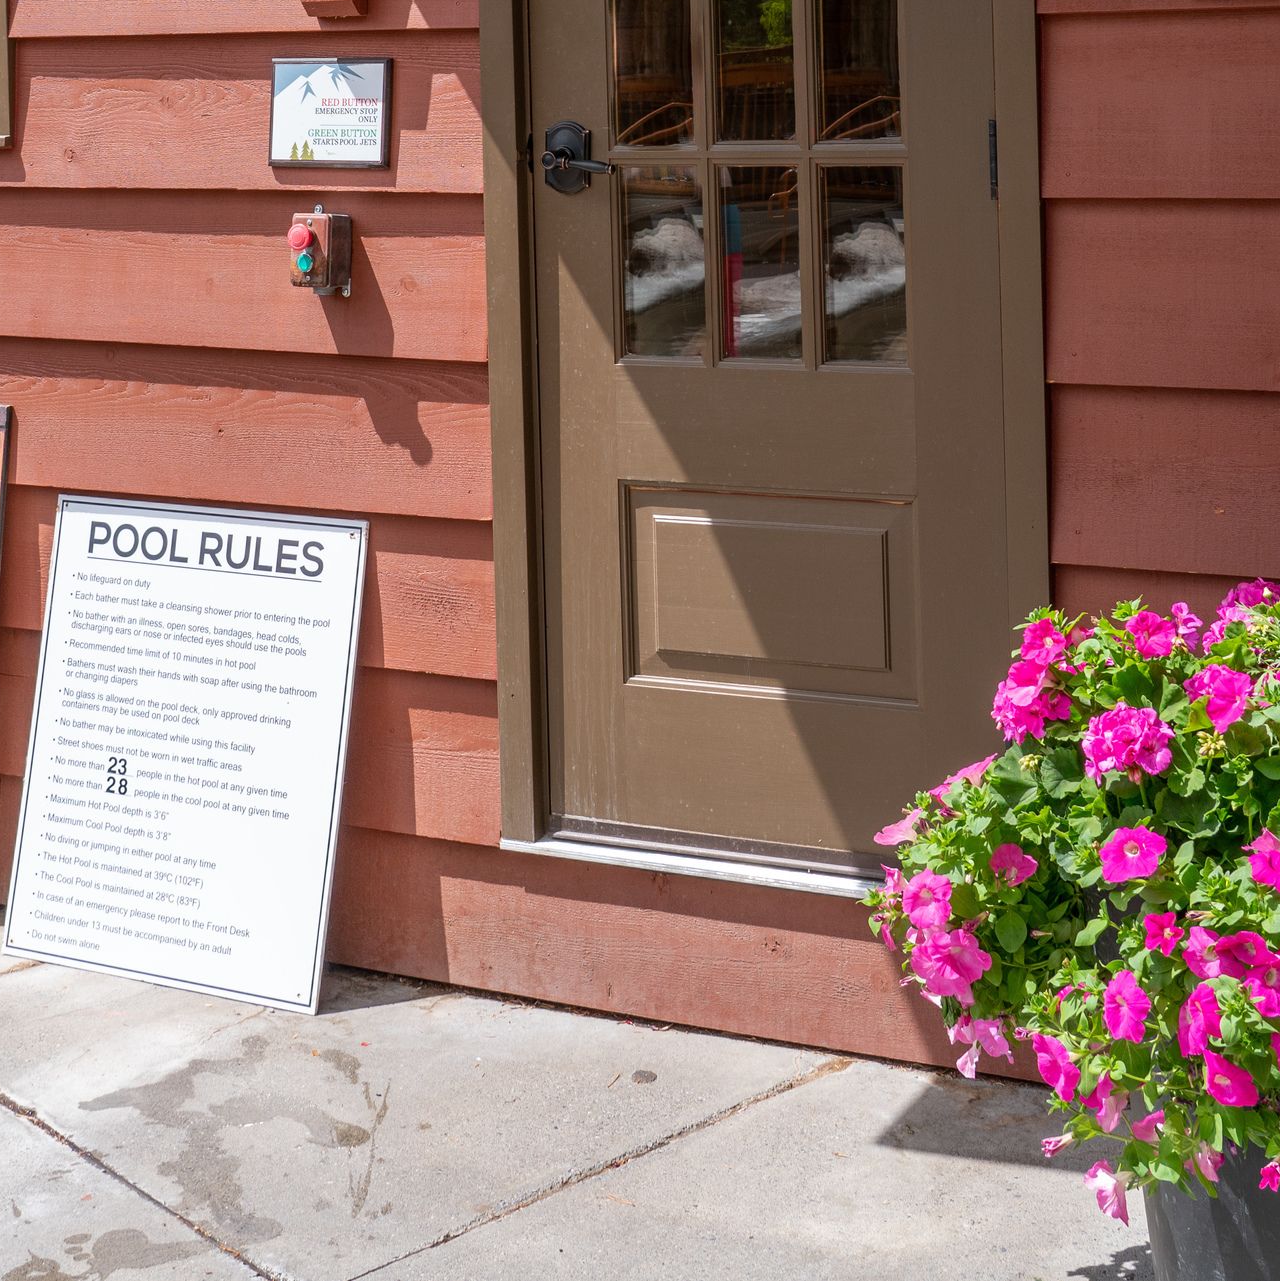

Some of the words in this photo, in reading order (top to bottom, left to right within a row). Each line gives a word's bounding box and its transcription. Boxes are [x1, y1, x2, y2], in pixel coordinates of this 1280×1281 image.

[322, 98, 339, 106] RED
[342, 98, 378, 106] BUTTON
[308, 129, 338, 137] GREEN
[341, 129, 377, 137] BUTTON
[87, 520, 188, 563] POOL
[197, 531, 324, 577] RULES
[76, 571, 88, 581] No
[89, 572, 122, 585] lifeguard
[122, 578, 133, 586] on
[134, 578, 151, 589] duty
[72, 608, 84, 619] No
[84, 610, 109, 621] bather
[110, 614, 126, 623] with
[138, 616, 164, 629] illness,
[166, 621, 186, 631] open
[187, 624, 211, 635] sores,
[212, 625, 254, 640] bandages,
[255, 630, 277, 642] head
[277, 634, 301, 646] colds,
[74, 590, 94, 600] Each
[95, 592, 120, 603] bather
[120, 597, 139, 606] must
[140, 598, 157, 608] take
[158, 601, 164, 609] a
[165, 601, 202, 615] cleansing
[203, 605, 232, 616] shower
[233, 608, 252, 619] prior
[253, 611, 262, 620] to
[263, 613, 296, 625] entering
[297, 615, 311, 626] the
[312, 618, 330, 628] pool
[68, 638, 125, 654] Recommended
[126, 646, 143, 656] time
[144, 647, 161, 658] limit
[161, 650, 170, 659] of
[172, 651, 181, 661] 10
[182, 654, 214, 665] minutes
[214, 655, 223, 666] in
[224, 657, 237, 668] hot
[238, 661, 256, 670] pool
[70, 619, 114, 635] discharging
[114, 626, 132, 636] ears
[132, 628, 141, 636] or
[142, 630, 162, 639] nose
[162, 632, 172, 640] or
[172, 631, 204, 644] infected
[204, 637, 224, 647] eyes
[225, 638, 252, 650] should
[253, 643, 269, 652] use
[270, 643, 283, 654] the
[284, 647, 307, 657] pools
[64, 669, 74, 677] or
[74, 669, 109, 684] changing
[109, 674, 138, 686] diapers
[66, 657, 95, 669] Bathers
[96, 663, 116, 672] must
[117, 665, 137, 675] wash
[138, 666, 156, 677] their
[157, 669, 181, 680] hands
[182, 672, 198, 682] with
[199, 676, 219, 687] soap
[220, 677, 239, 688] after
[240, 680, 262, 693] using
[264, 683, 277, 693] the
[278, 684, 317, 698] bathroom
[61, 699, 100, 711] containers
[101, 704, 118, 716] may
[119, 705, 129, 716] be
[130, 709, 150, 718] used
[150, 712, 161, 720] on
[162, 713, 180, 723] pool
[180, 714, 200, 725] deck
[62, 687, 74, 697] No
[75, 689, 96, 700] glass
[96, 691, 104, 701] is
[104, 693, 135, 705] allowed
[135, 698, 146, 706] on
[147, 698, 160, 709] the
[160, 702, 178, 711] pool
[201, 707, 219, 718] only
[220, 710, 258, 722] approved
[258, 713, 291, 728] drinking
[57, 735, 80, 748] Street
[80, 740, 104, 751] shoes
[105, 744, 124, 754] must
[125, 747, 138, 756] not
[139, 748, 149, 758] be
[150, 751, 170, 761] worn
[171, 753, 179, 762] in
[180, 756, 195, 765] wet
[196, 757, 218, 768] traffic
[219, 761, 242, 772] areas
[59, 716, 71, 727] No
[71, 718, 96, 730] bather
[97, 723, 114, 735] may
[115, 724, 126, 734] be
[126, 726, 168, 741] intoxicated
[169, 733, 190, 744] while
[190, 737, 213, 749] using
[214, 739, 229, 750] this
[230, 740, 256, 754] facility
[54, 754, 66, 765] No
[67, 758, 87, 768] more
[88, 760, 105, 771] than
[106, 756, 127, 775] 23
[135, 769, 162, 780] people
[163, 770, 171, 781] in
[173, 773, 186, 783] the
[186, 775, 200, 786] hot
[201, 779, 219, 788] pool
[220, 781, 228, 790] at
[229, 783, 245, 794] any
[246, 784, 268, 796] given
[270, 787, 288, 799] time
[52, 773, 64, 784] No
[64, 777, 84, 788] more
[85, 779, 103, 790] than
[105, 775, 128, 795] 28
[133, 788, 160, 800] people
[161, 789, 169, 800] in
[170, 792, 183, 803] the
[184, 796, 202, 806] cool
[202, 799, 220, 809] pool
[221, 802, 230, 811] at
[231, 804, 247, 814] any
[247, 805, 270, 817] given
[271, 808, 290, 820] time
[31, 928, 43, 940] Do
[43, 933, 56, 942] not
[57, 936, 78, 946] swim
[78, 938, 100, 951] alone
